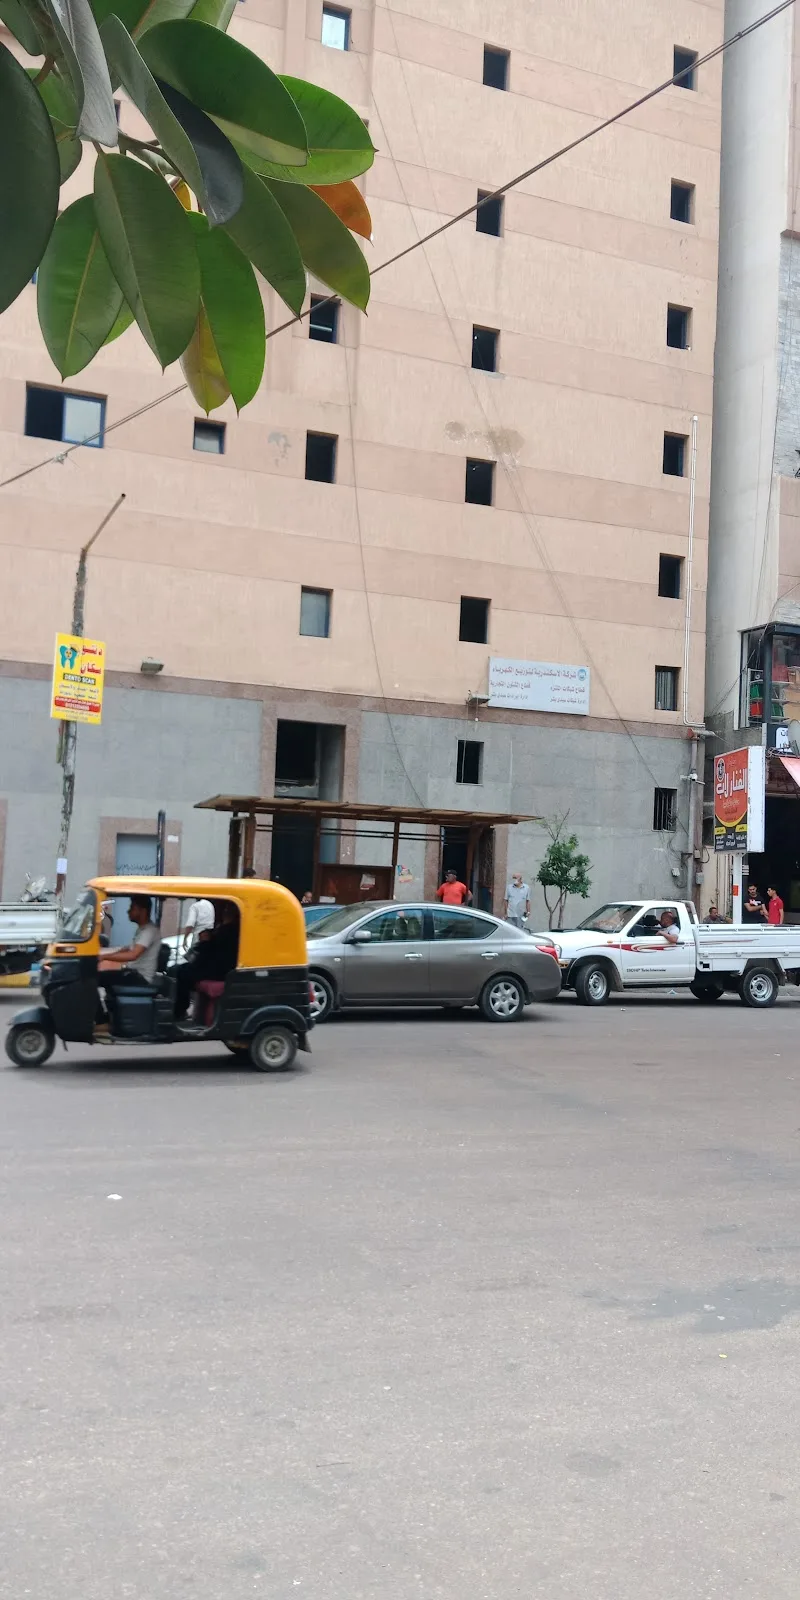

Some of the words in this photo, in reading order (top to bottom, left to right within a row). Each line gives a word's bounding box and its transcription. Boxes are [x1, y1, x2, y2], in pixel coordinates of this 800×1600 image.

[493, 666, 514, 674] الكهرباء
[516, 666, 534, 676] لتوزيع
[562, 671, 576, 679] شركة
[729, 768, 748, 797] الفنار
